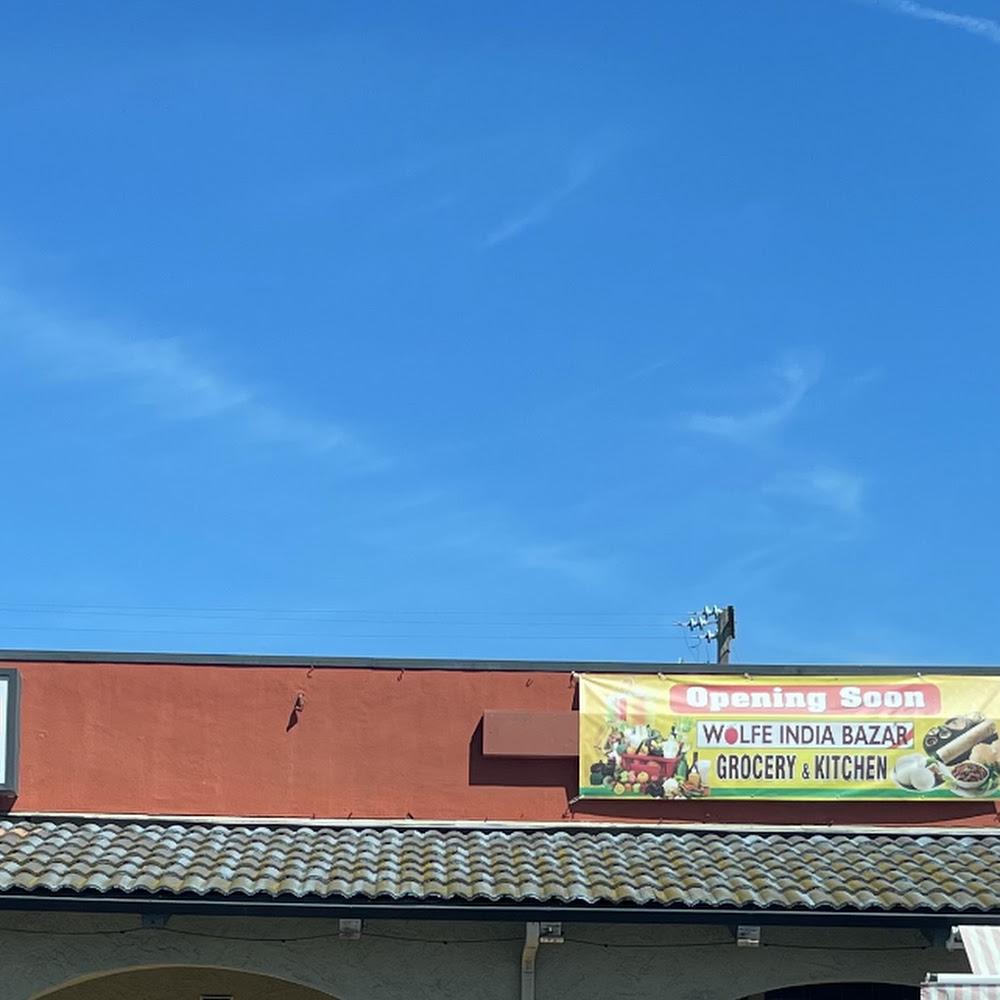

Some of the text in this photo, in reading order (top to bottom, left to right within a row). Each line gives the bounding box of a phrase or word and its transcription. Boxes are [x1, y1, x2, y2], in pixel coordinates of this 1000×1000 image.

[686, 686, 926, 712] Opening Soon
[703, 724, 908, 745] WOLFE INDIA BAZAR
[717, 754, 888, 780] GROCERY & KITCHEN
